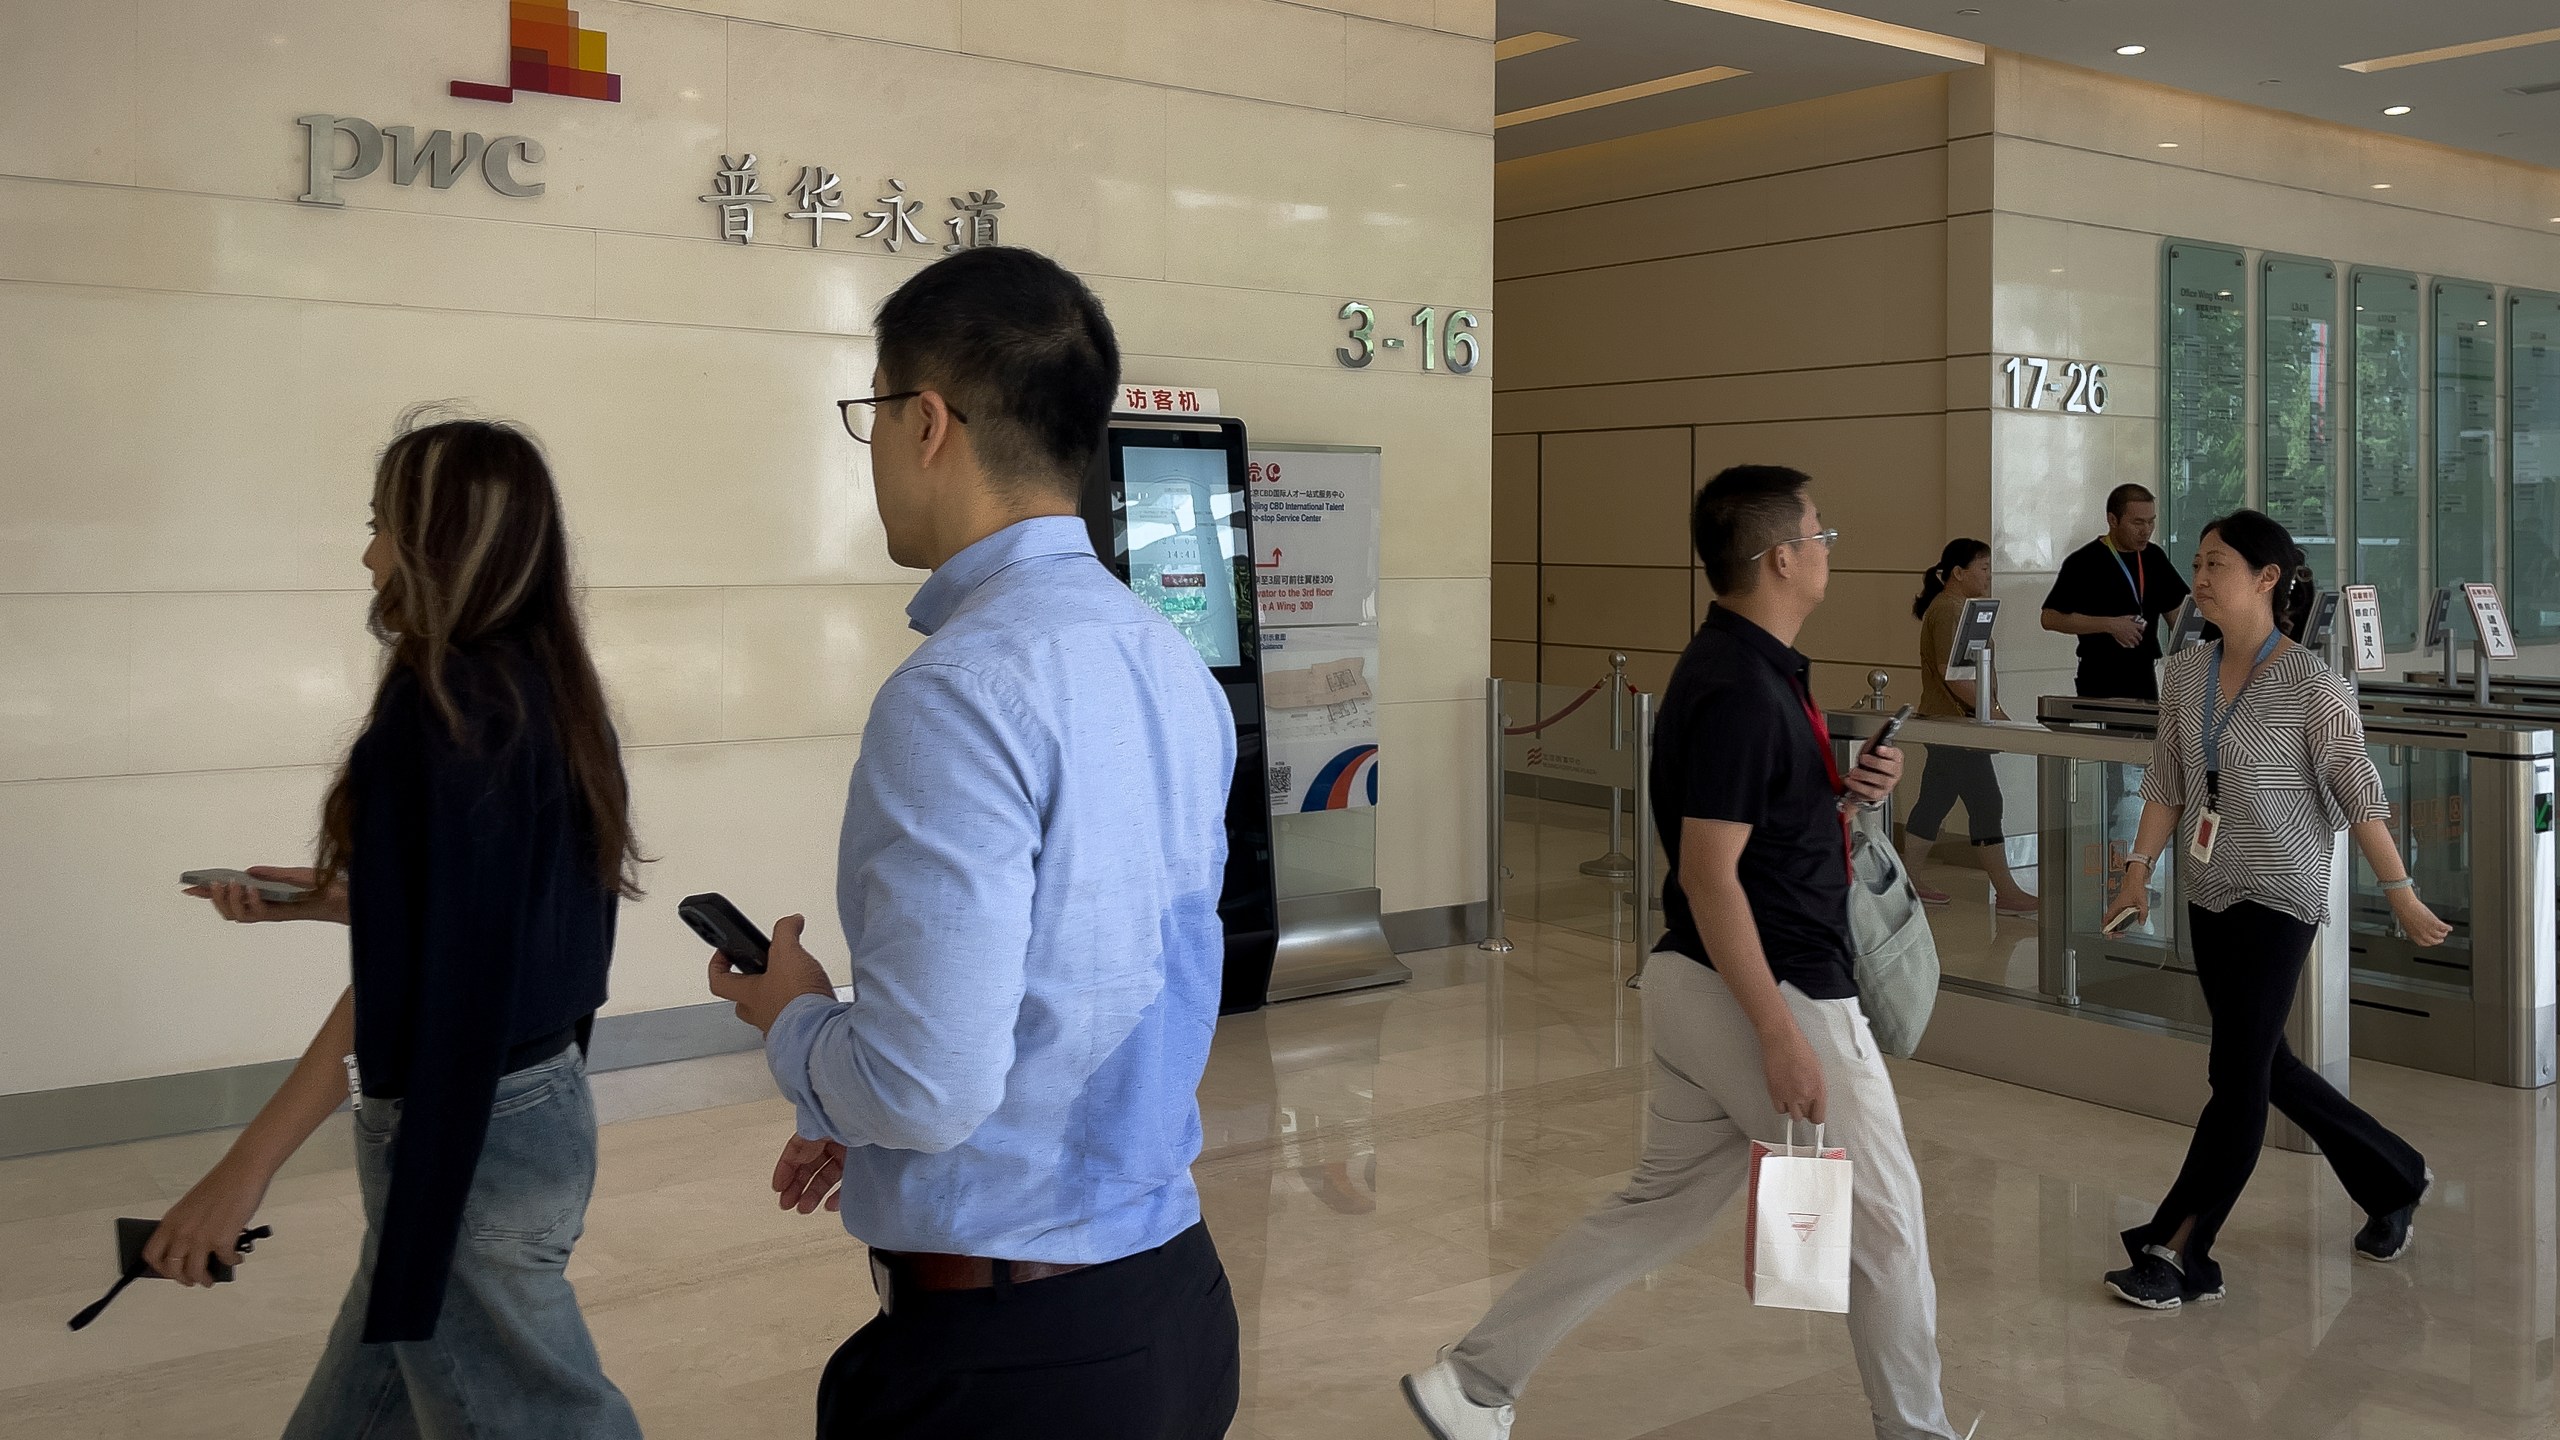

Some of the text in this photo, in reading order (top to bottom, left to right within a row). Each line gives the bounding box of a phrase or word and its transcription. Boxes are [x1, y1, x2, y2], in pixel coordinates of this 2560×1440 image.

[297, 114, 546, 207] pwc
[698, 153, 1005, 252] 普华永道
[1336, 301, 1480, 374] 3-16
[2003, 357, 2108, 414] 17-26
[1126, 388, 1200, 412] 访客机
[1269, 502, 1284, 510] CBD
[1285, 502, 1325, 511] International
[1325, 502, 1345, 511] Talent
[1276, 514, 1300, 522] Service
[1301, 514, 1322, 522] Center
[1278, 589, 1287, 597] to
[1288, 588, 1300, 597] the
[1301, 588, 1315, 597] 3rd
[1316, 588, 1334, 597] floor
[1268, 602, 1275, 610] A
[1277, 601, 1296, 612] Wing
[1300, 601, 1314, 610] 309
